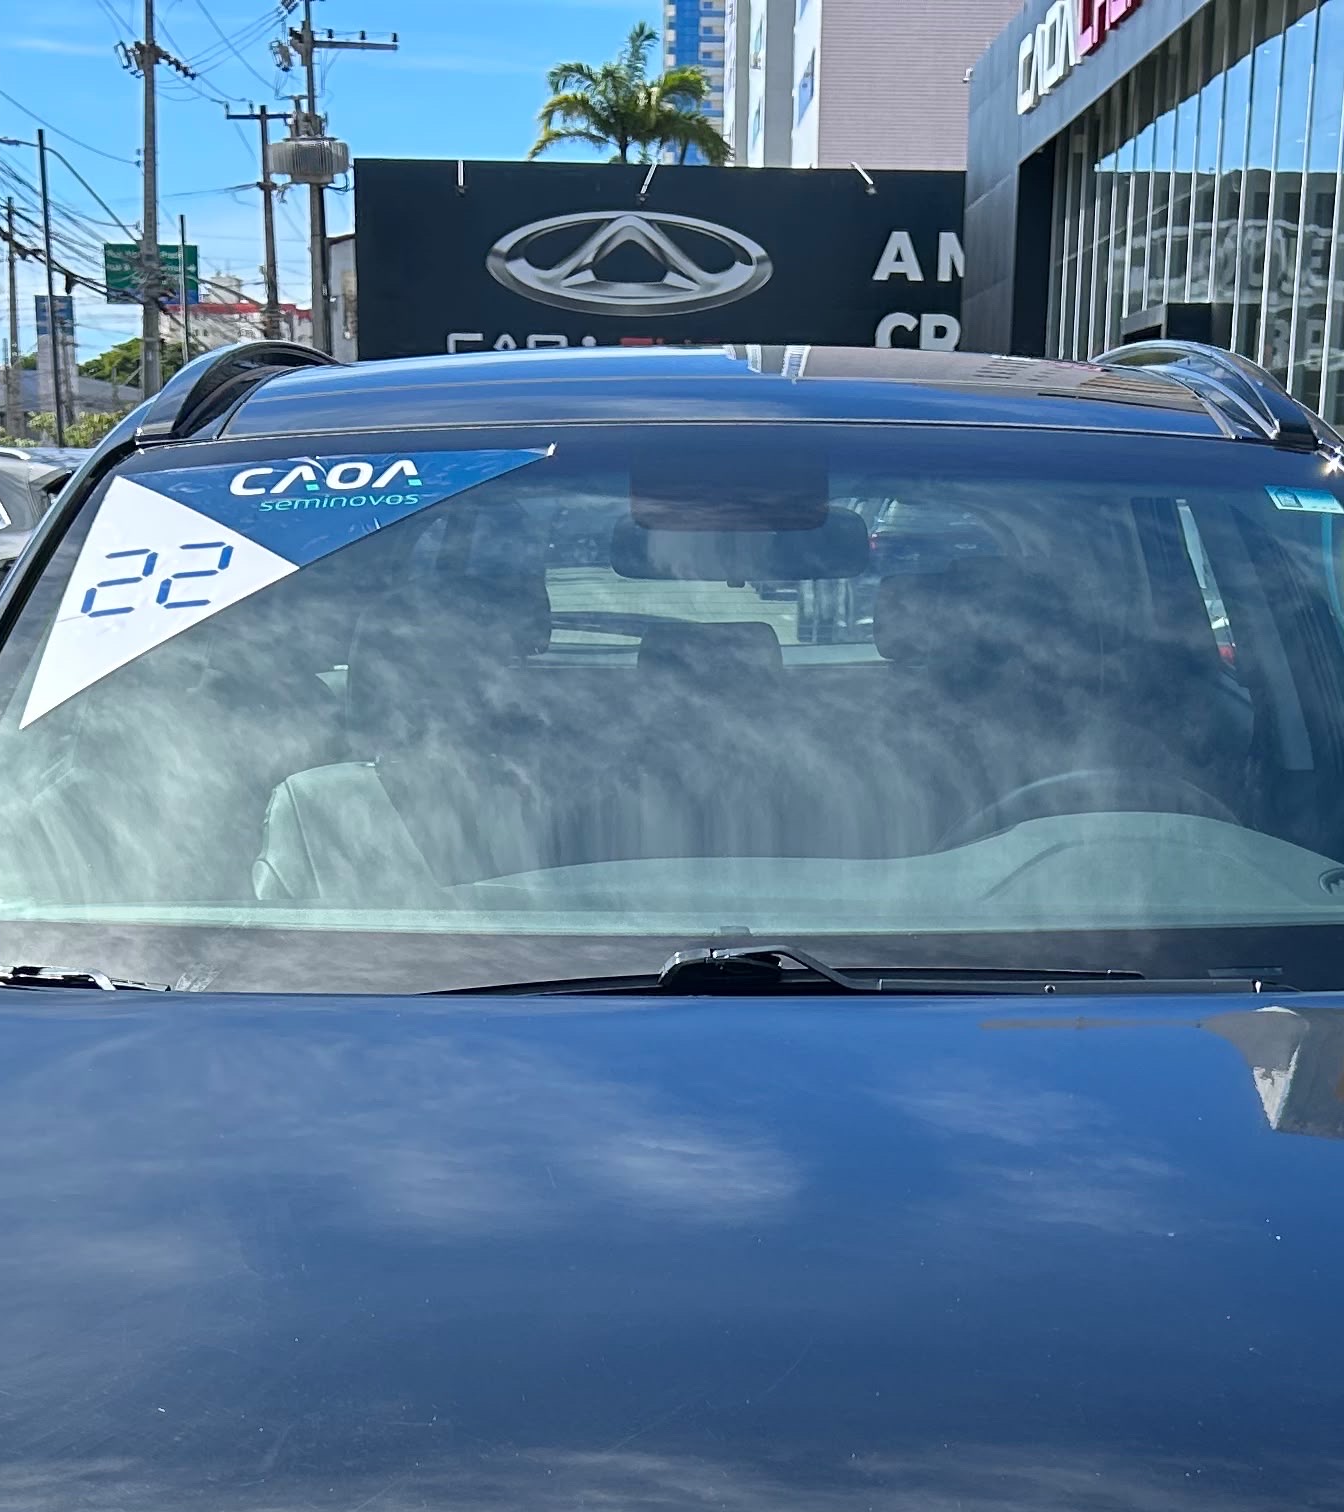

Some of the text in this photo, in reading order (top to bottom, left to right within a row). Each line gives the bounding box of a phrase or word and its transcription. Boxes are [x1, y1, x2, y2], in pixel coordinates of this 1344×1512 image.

[1017, 0, 1082, 115] CAOA
[229, 459, 423, 496] CAOA
[258, 492, 420, 512] seminovos
[80, 541, 234, 619] 22
